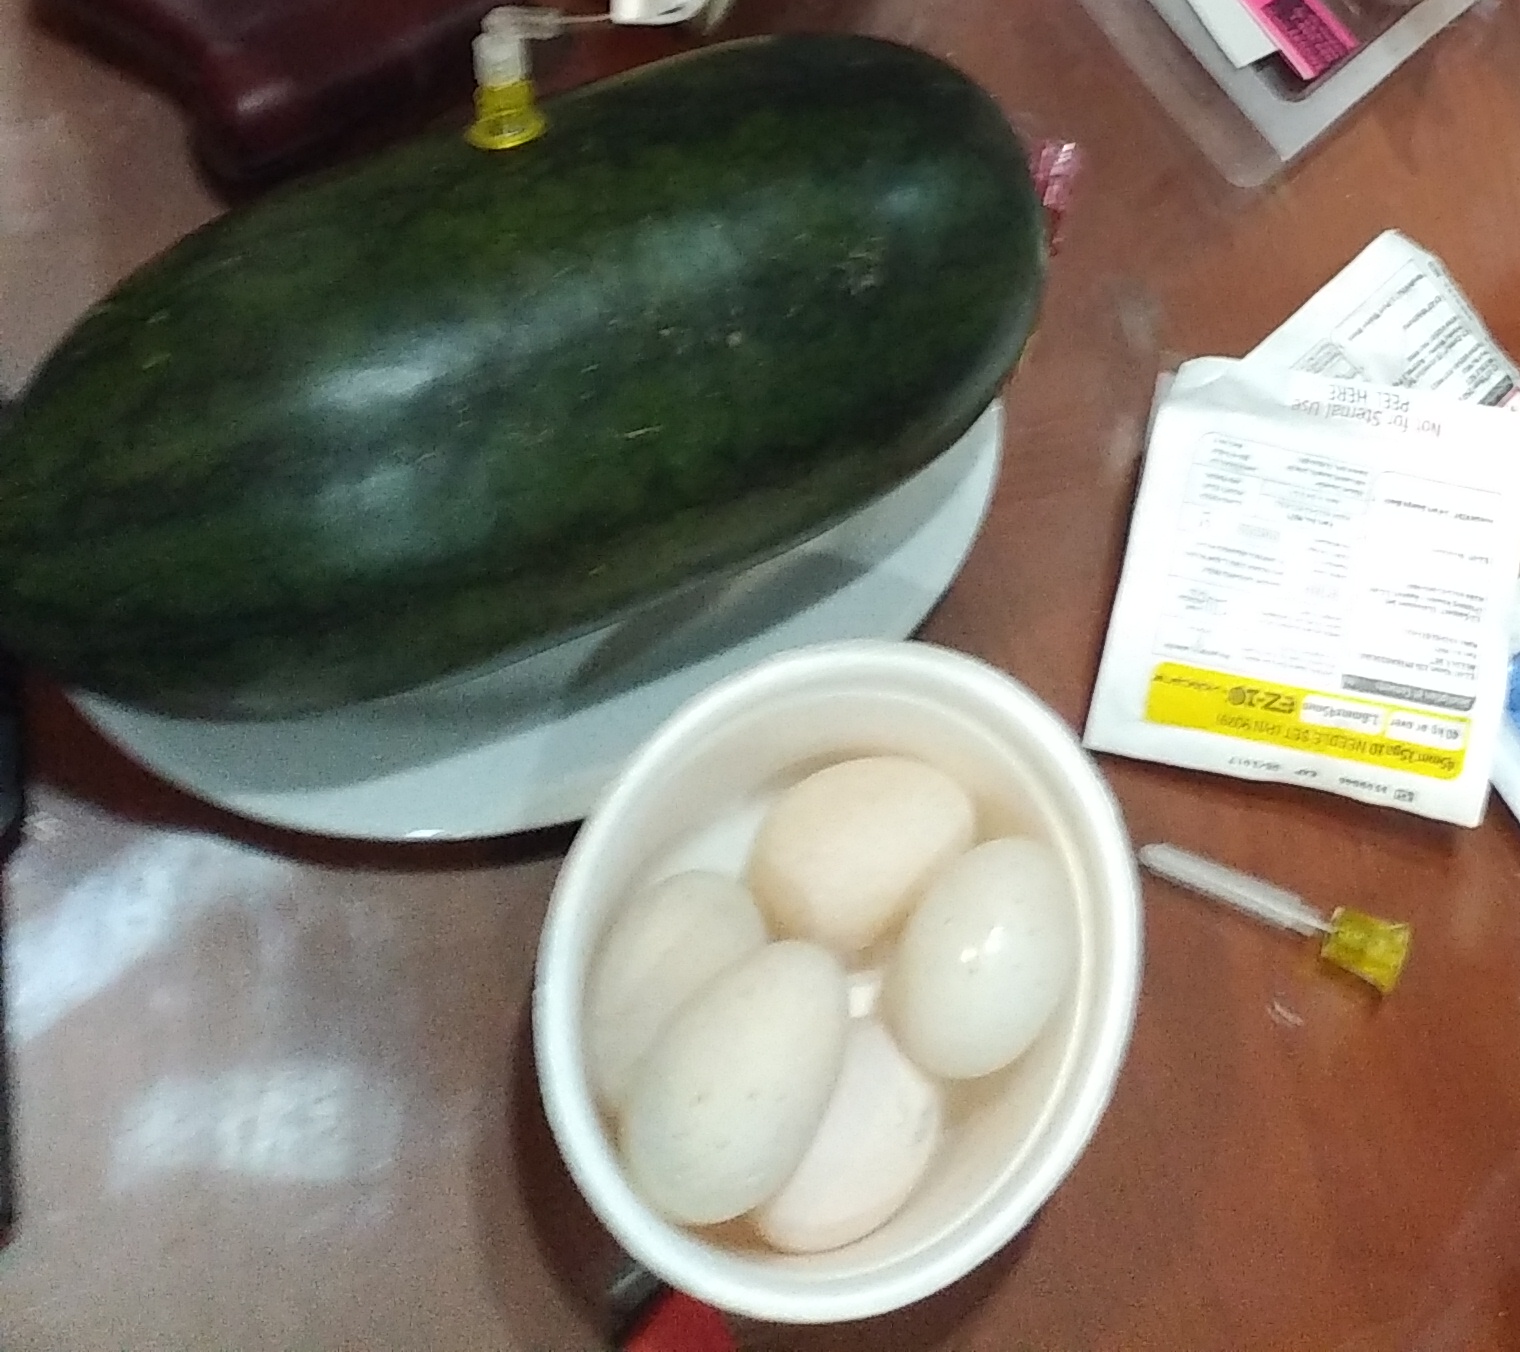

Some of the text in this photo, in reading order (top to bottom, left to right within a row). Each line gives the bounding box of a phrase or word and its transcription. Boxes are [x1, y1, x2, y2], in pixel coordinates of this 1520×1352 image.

[1329, 384, 1367, 403] HERE
[1291, 399, 1320, 416] Use
[1313, 733, 1368, 754] NEEDLE
